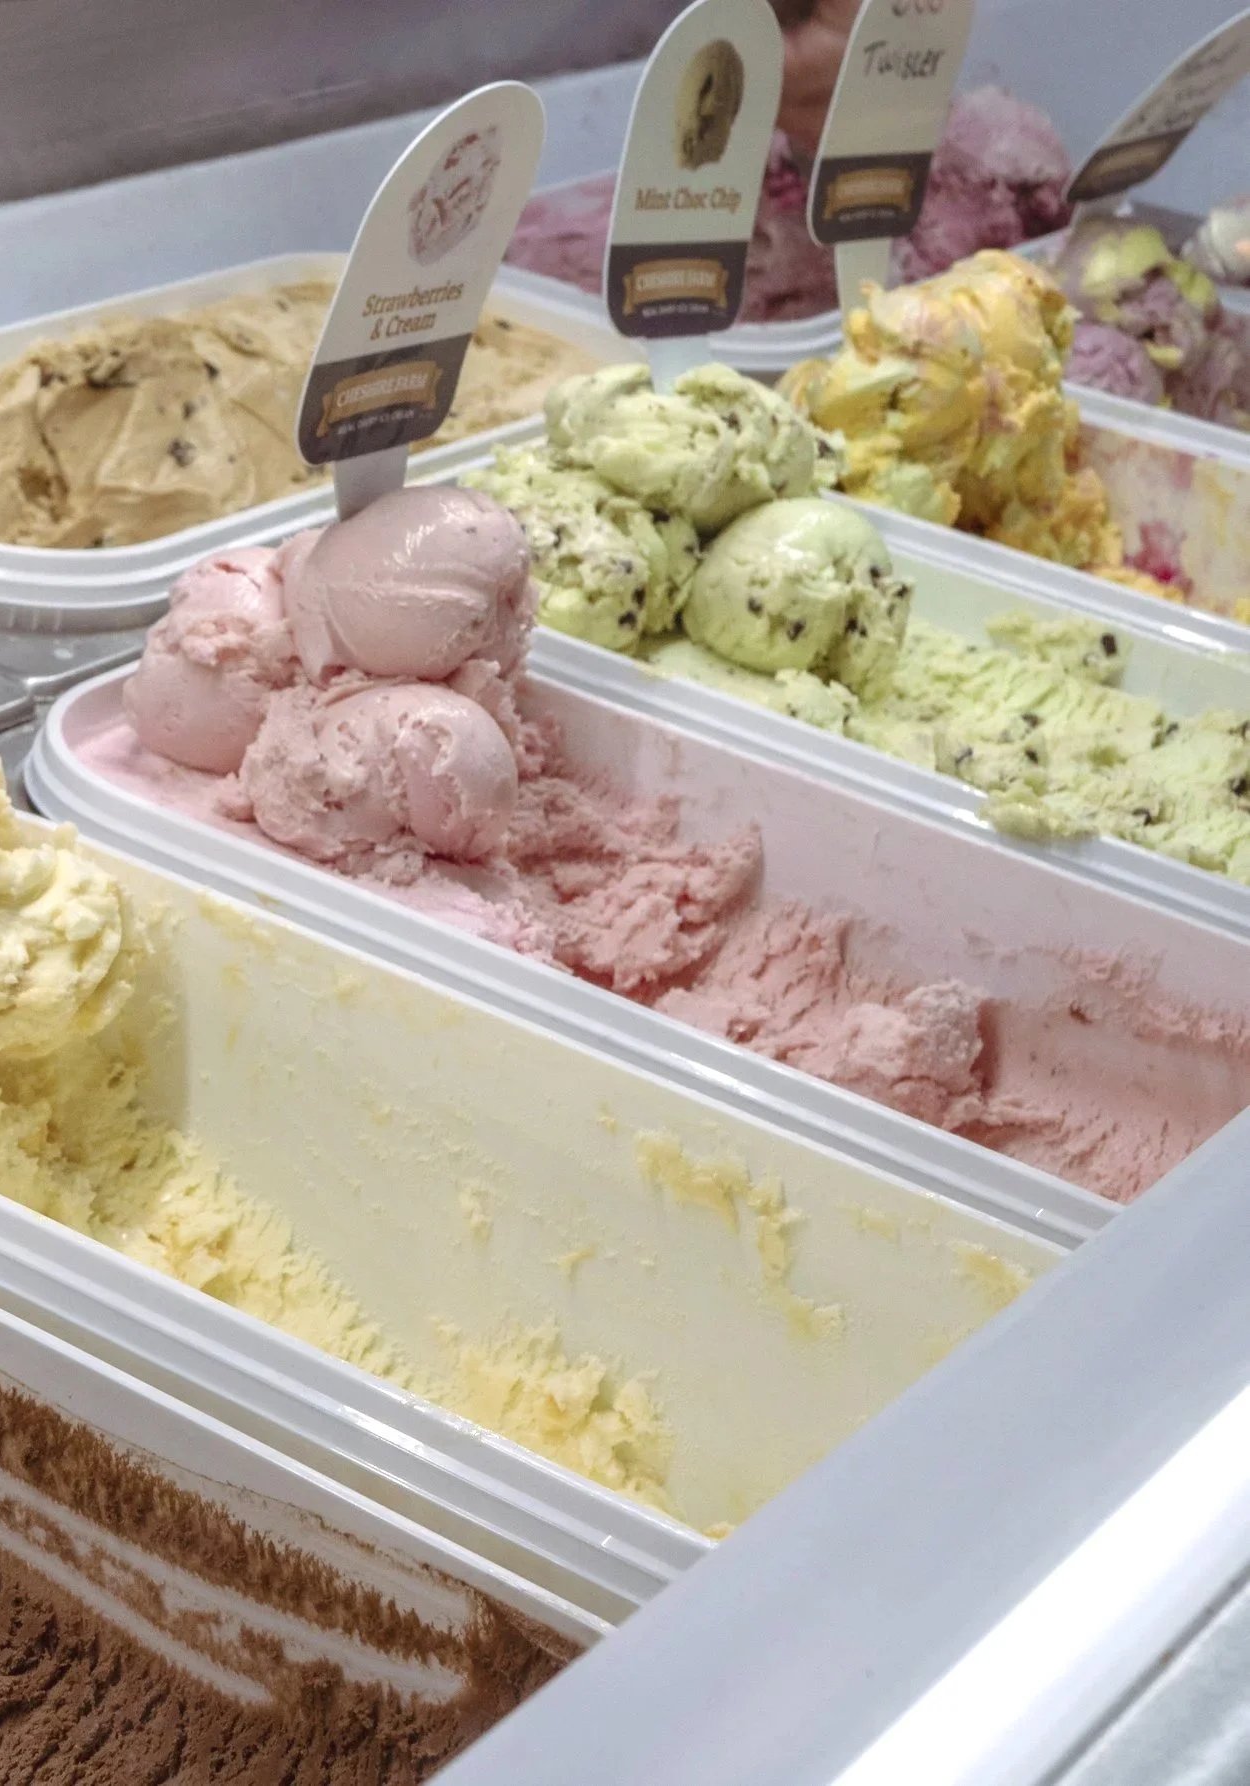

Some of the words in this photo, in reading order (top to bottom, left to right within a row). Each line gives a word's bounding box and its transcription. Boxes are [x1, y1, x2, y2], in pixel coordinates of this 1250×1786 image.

[634, 188, 671, 211] Mint
[673, 187, 708, 210] Choc
[711, 187, 742, 216] Chip
[362, 280, 464, 317] Strawberries
[370, 318, 381, 340] &
[385, 313, 437, 337] Cream
